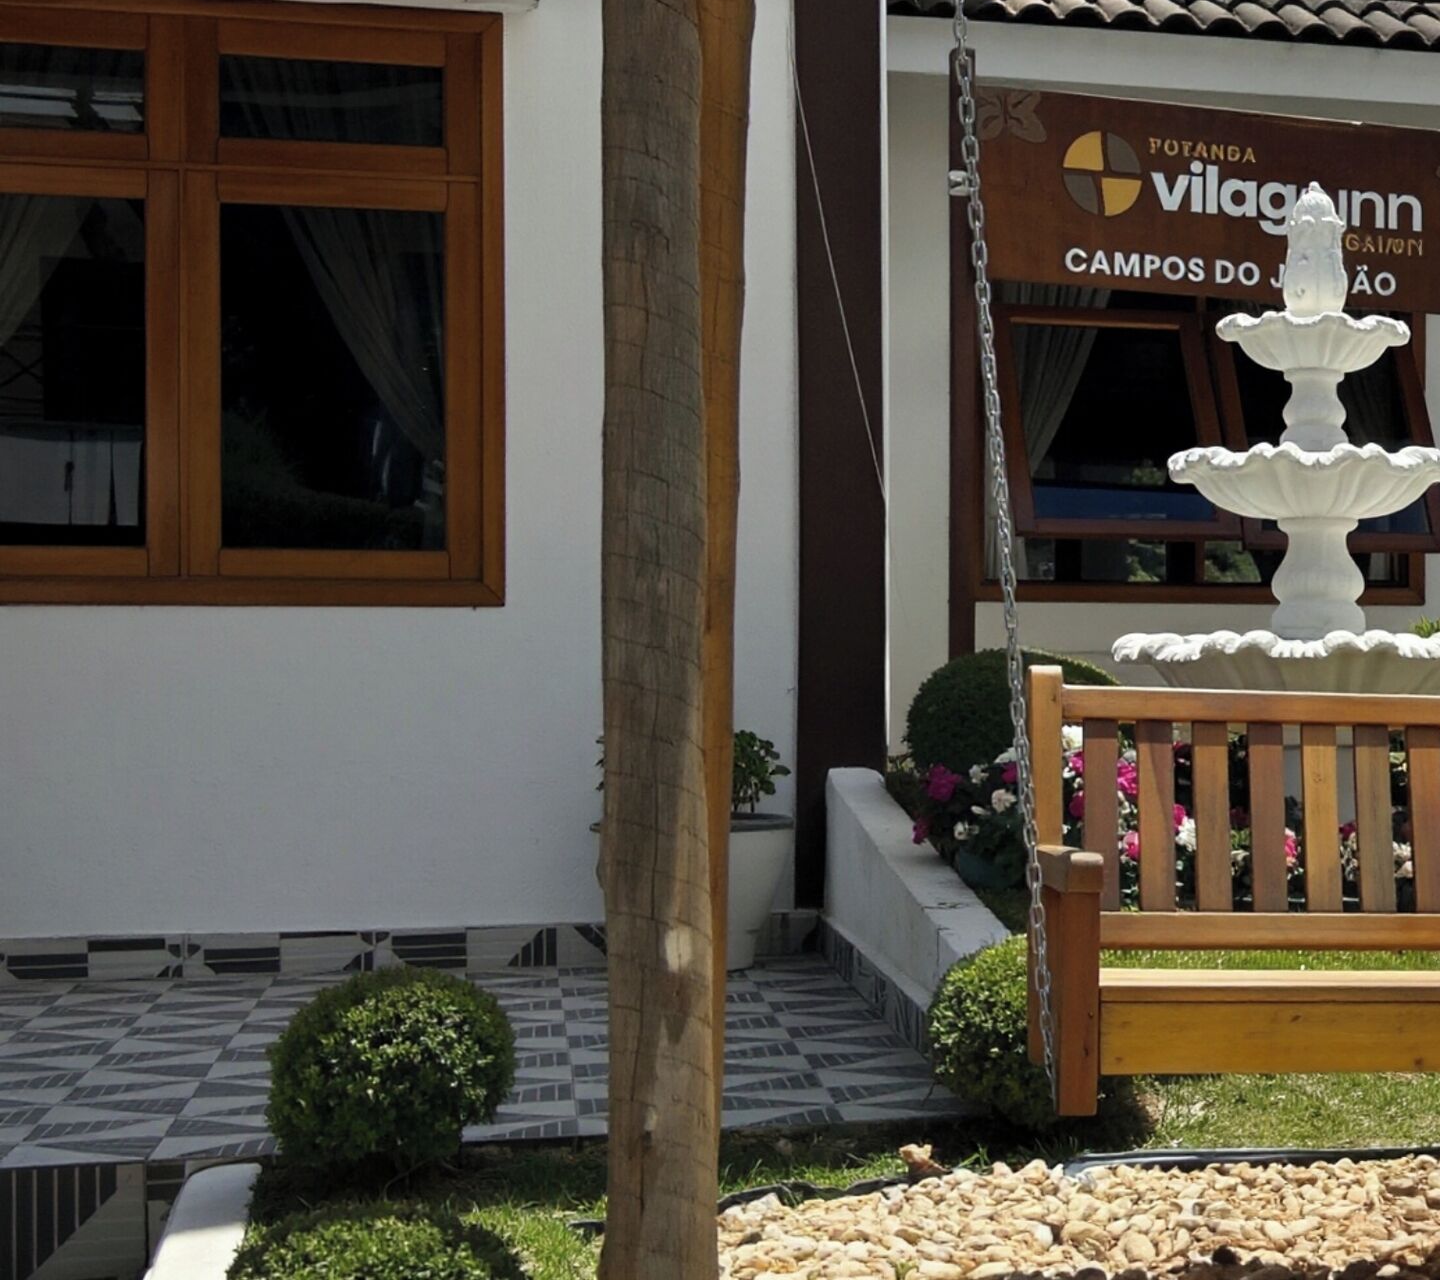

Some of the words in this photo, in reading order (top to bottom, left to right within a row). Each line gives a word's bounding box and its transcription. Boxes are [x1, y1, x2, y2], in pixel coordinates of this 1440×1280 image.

[1064, 247, 1206, 283] CAMPOS
[1214, 258, 1261, 287] DO
[1270, 263, 1397, 297] JÃO
